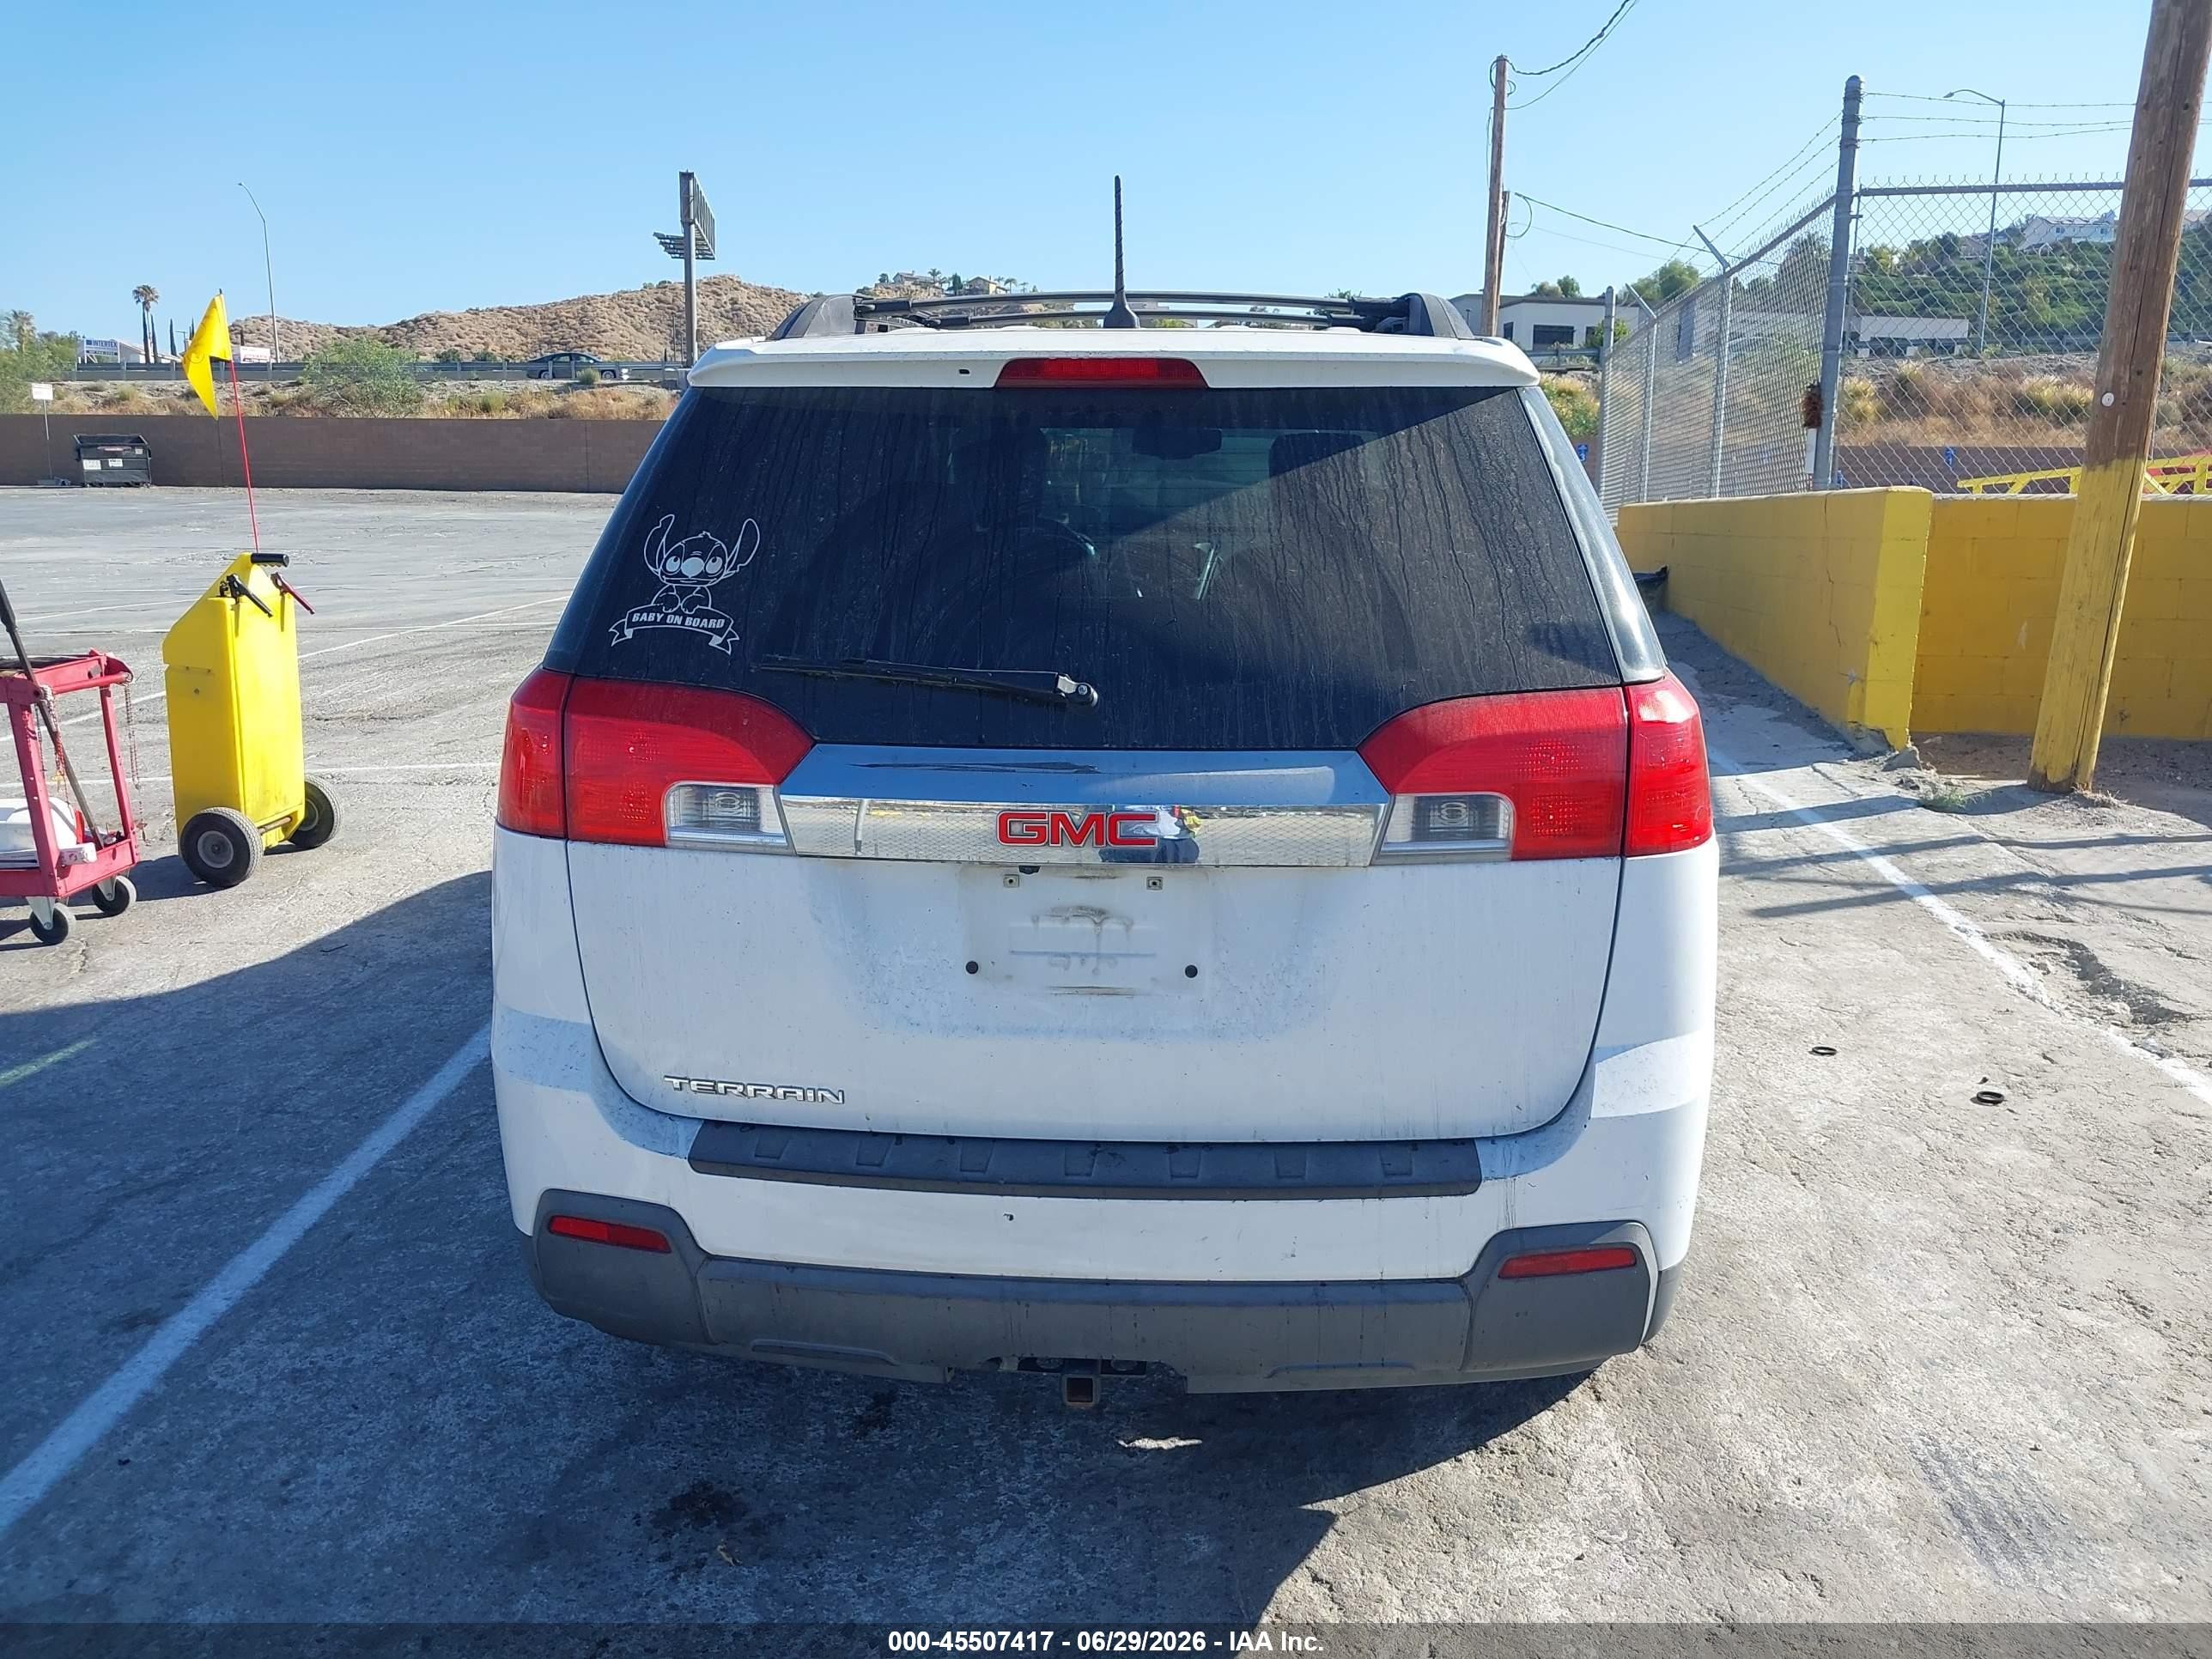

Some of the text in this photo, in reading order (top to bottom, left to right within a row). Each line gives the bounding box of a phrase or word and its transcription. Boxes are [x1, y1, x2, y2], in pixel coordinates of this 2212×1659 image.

[631, 612, 726, 629] BABY ON BOARD
[996, 810, 1158, 848] GMC
[663, 1075, 845, 1105] TERRAIN
